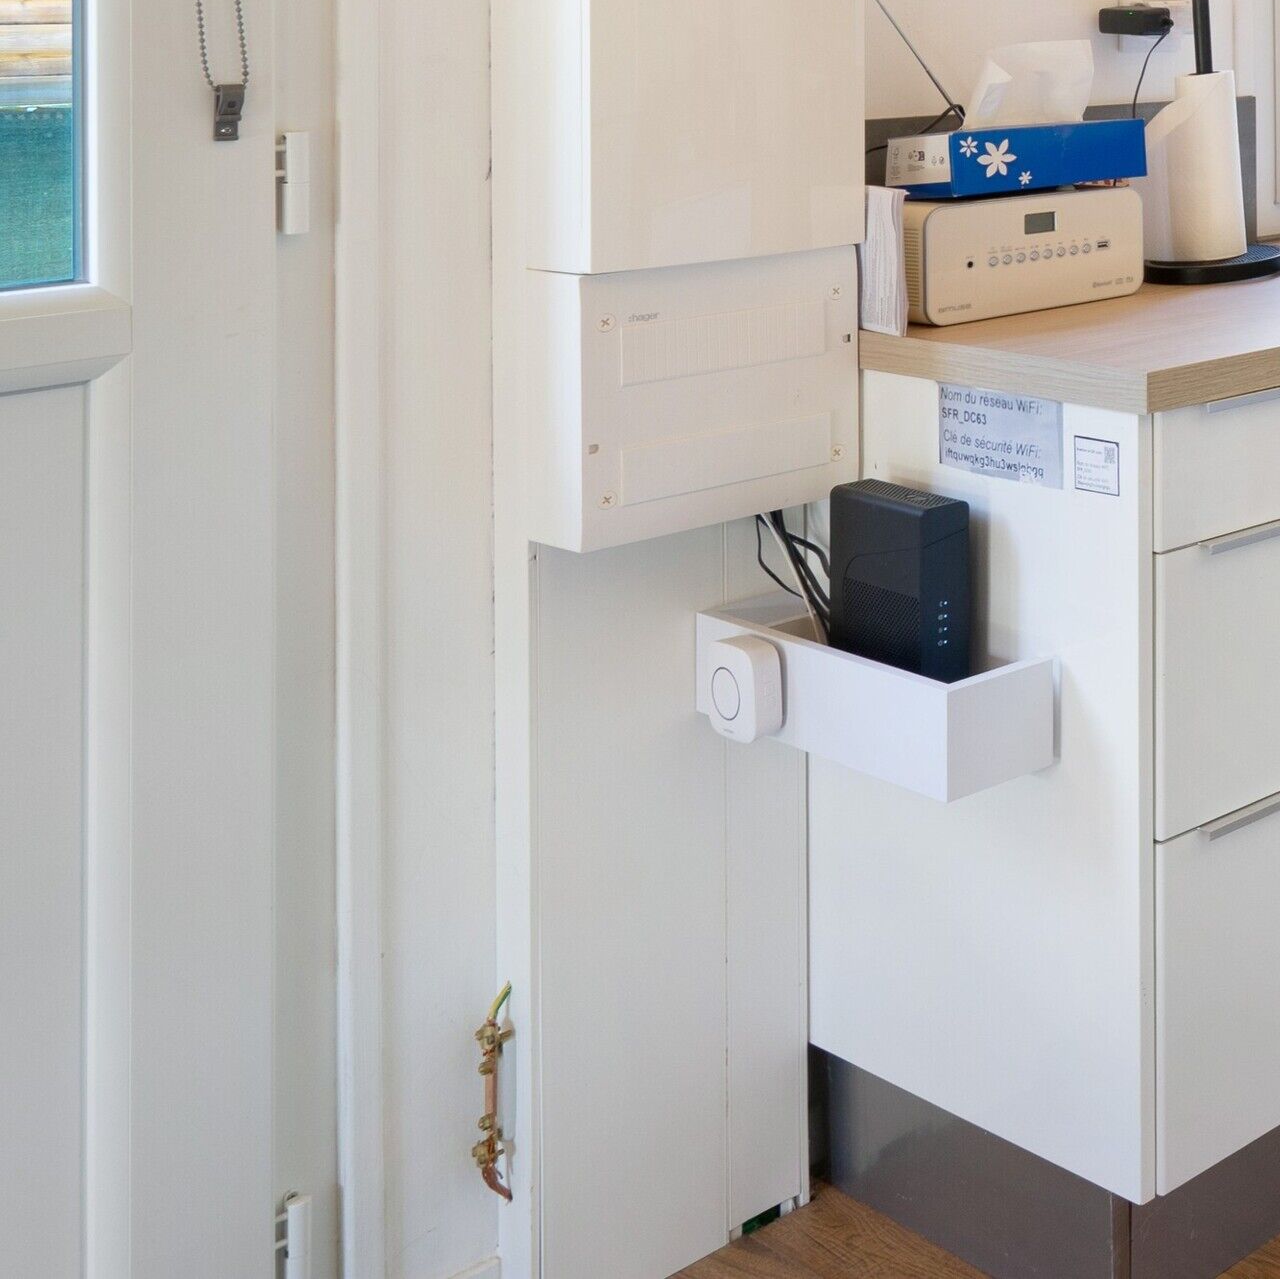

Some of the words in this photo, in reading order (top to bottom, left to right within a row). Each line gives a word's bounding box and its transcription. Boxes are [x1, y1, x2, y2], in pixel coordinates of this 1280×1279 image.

[940, 387, 962, 402] Nom
[965, 392, 976, 404] du
[960, 434, 972, 446] de
